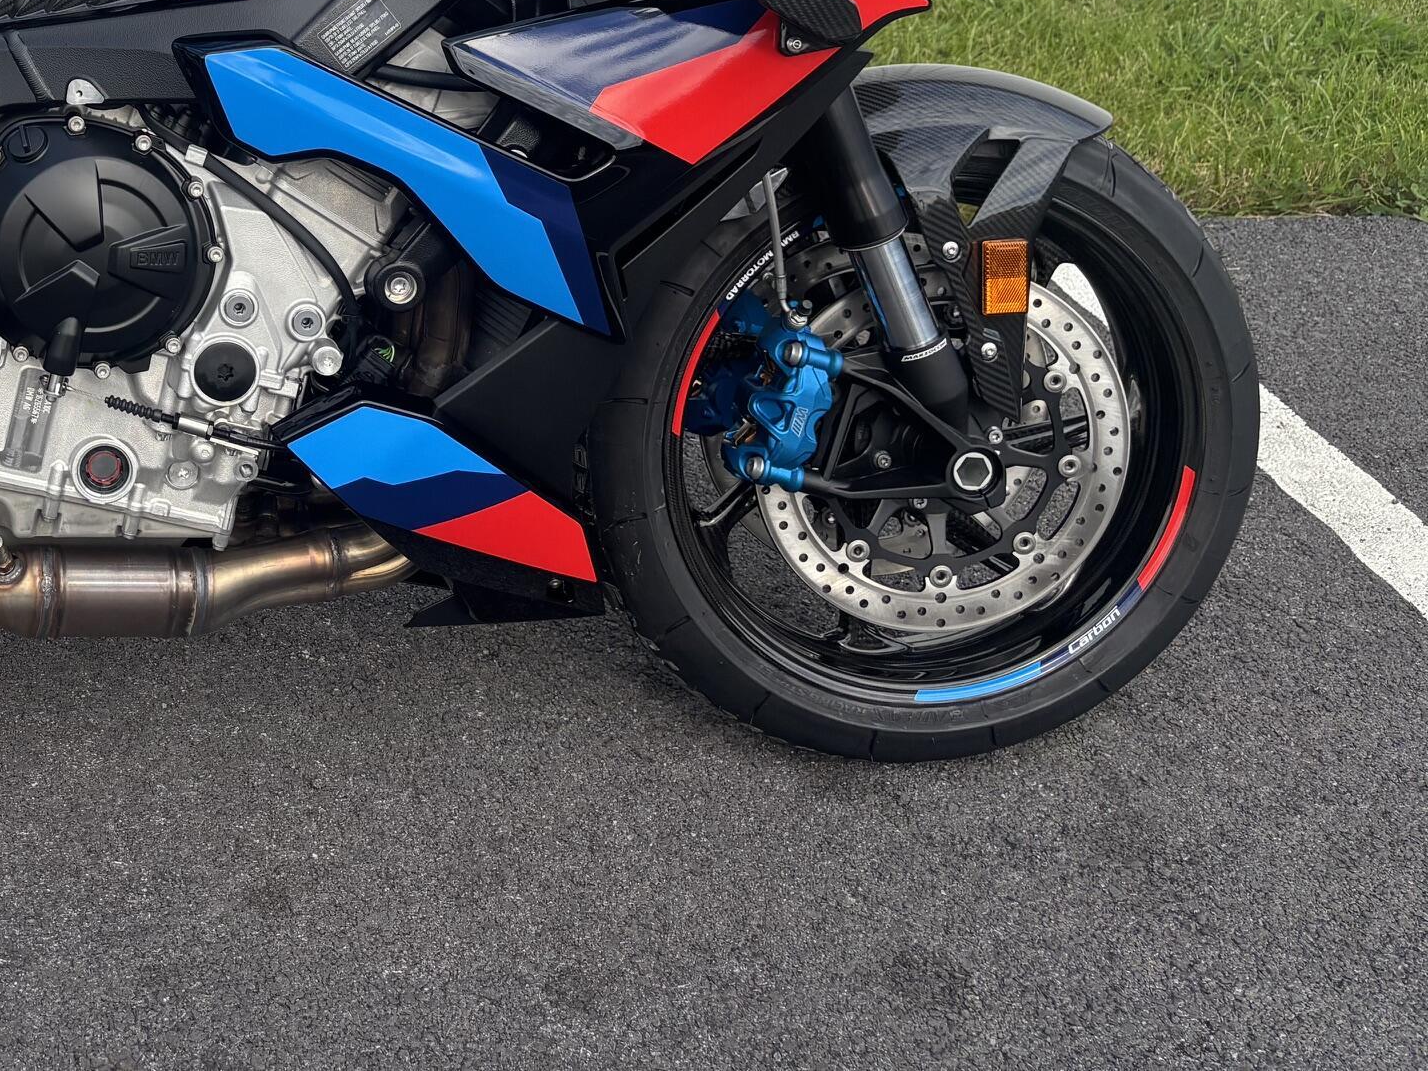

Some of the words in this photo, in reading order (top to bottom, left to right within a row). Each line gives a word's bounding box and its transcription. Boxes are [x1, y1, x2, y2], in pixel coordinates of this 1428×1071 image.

[780, 230, 800, 247] BM
[137, 251, 180, 266] BMW
[725, 250, 774, 300] MOTORRAD
[1068, 606, 1121, 654] Carbon
